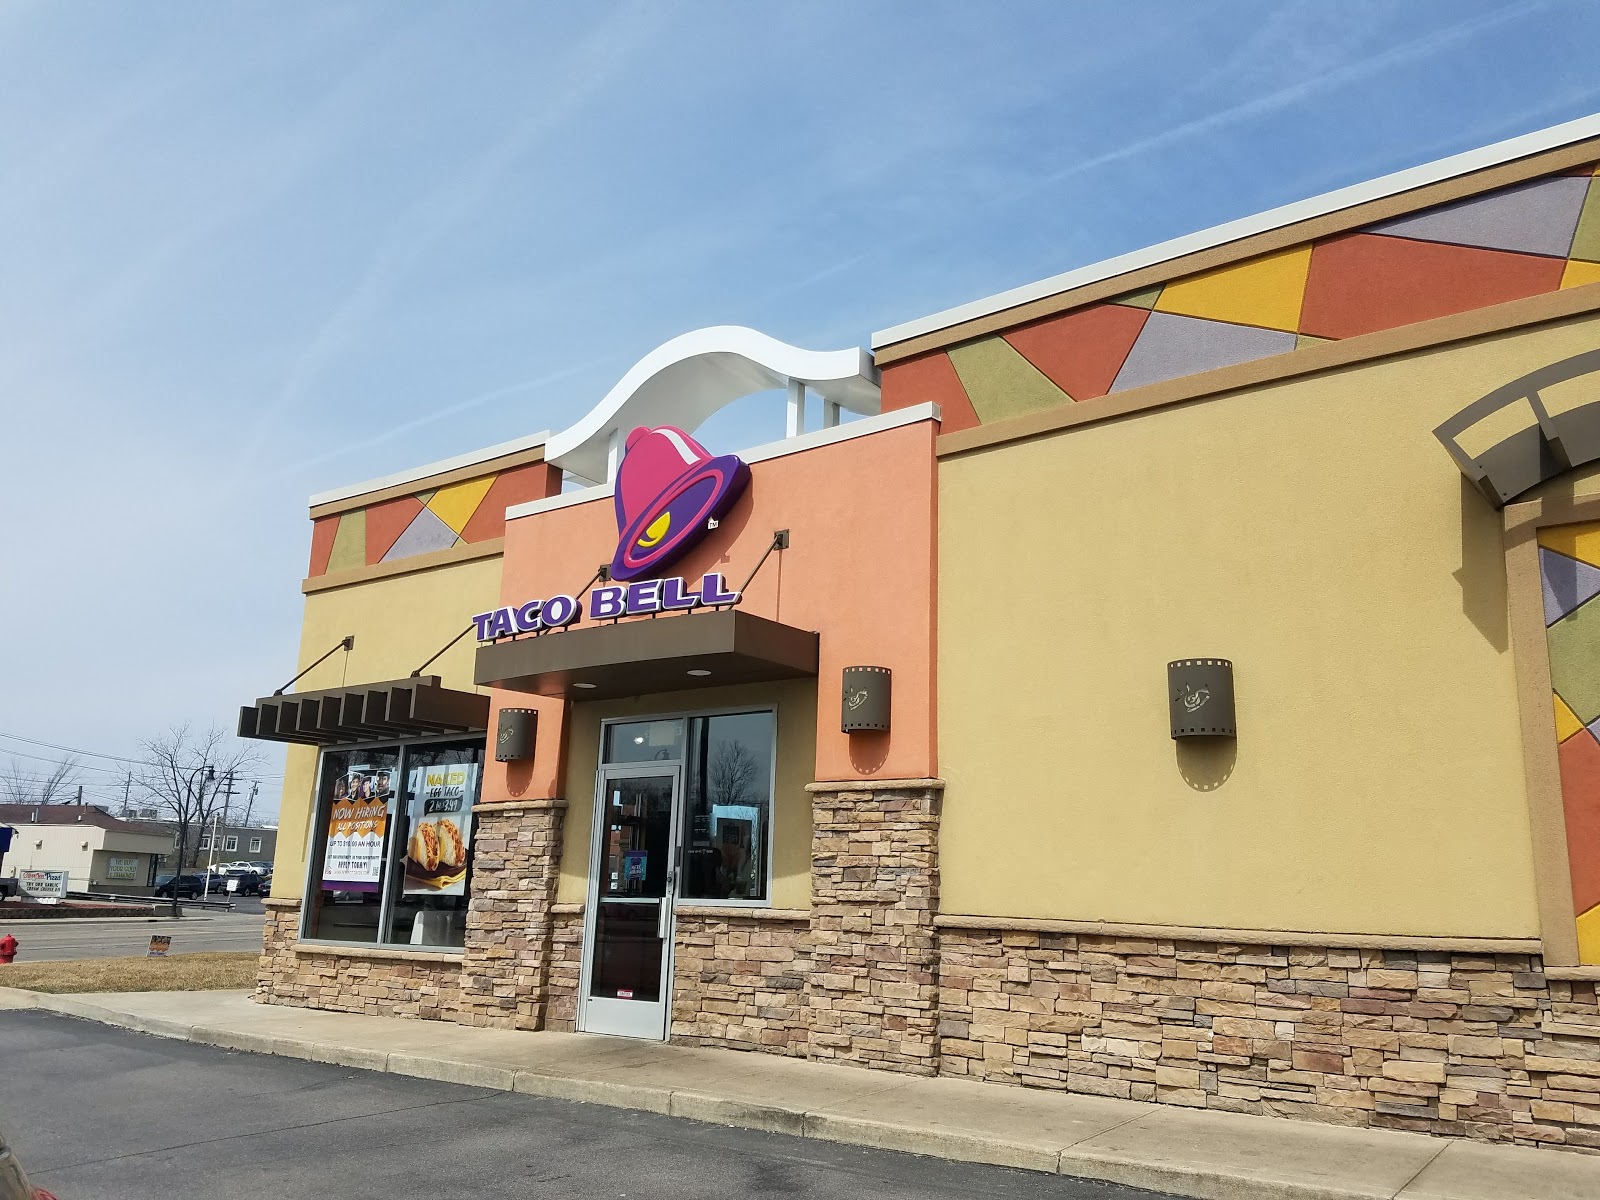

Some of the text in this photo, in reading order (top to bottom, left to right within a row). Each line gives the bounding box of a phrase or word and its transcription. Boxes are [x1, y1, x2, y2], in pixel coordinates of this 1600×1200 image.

[472, 572, 741, 642] TACO BELL
[427, 772, 465, 786] NAKED
[429, 801, 435, 812] 2
[333, 807, 354, 820] NOW
[337, 820, 378, 831] ALL POSITIONS
[338, 861, 351, 869] APPLY
